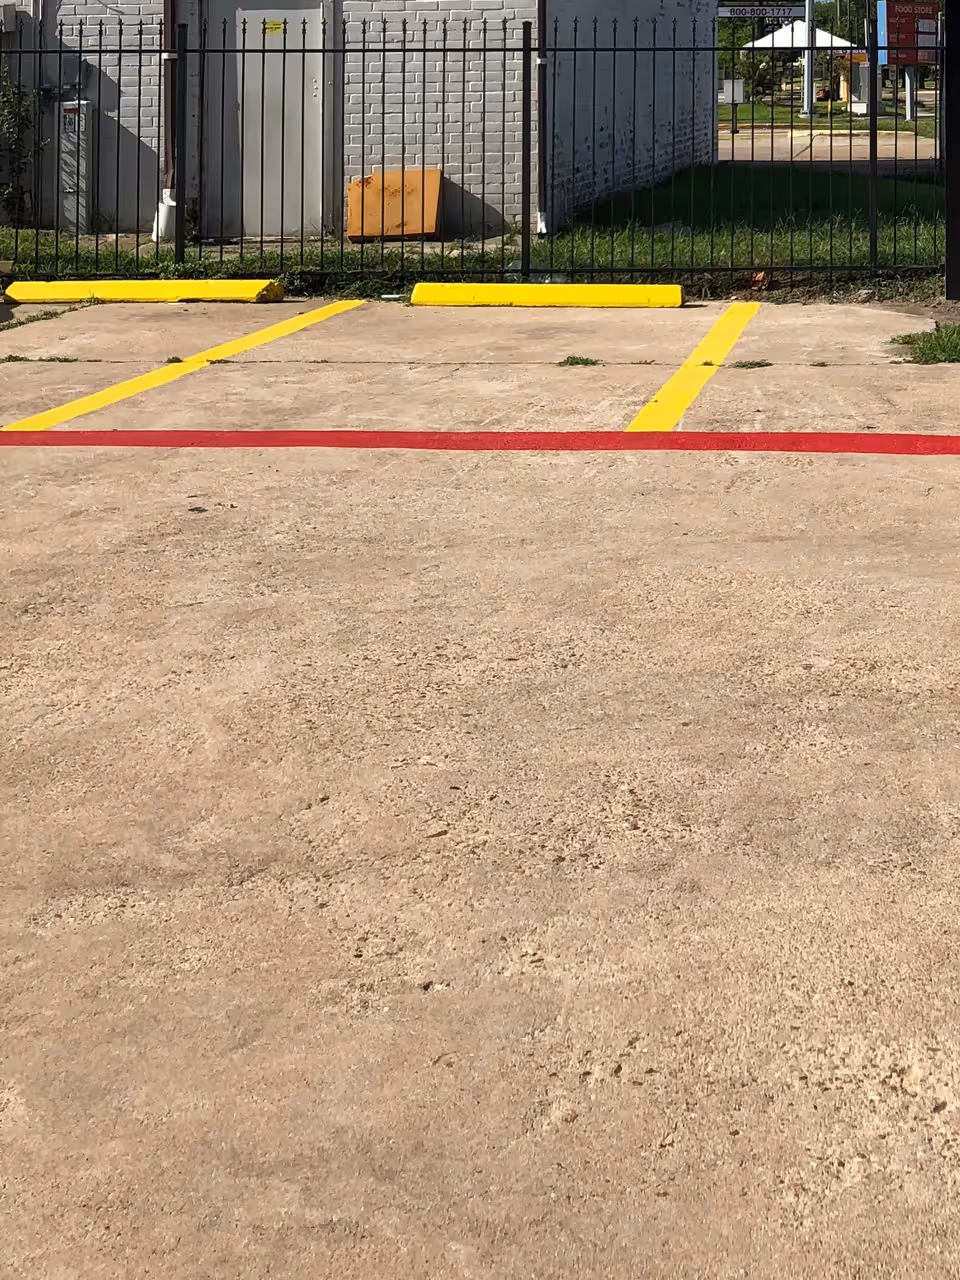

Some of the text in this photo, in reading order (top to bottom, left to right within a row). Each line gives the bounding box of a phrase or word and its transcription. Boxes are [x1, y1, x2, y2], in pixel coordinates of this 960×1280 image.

[729, 7, 793, 17] 800-800-1717
[895, 5, 933, 14] FOOD STORE
